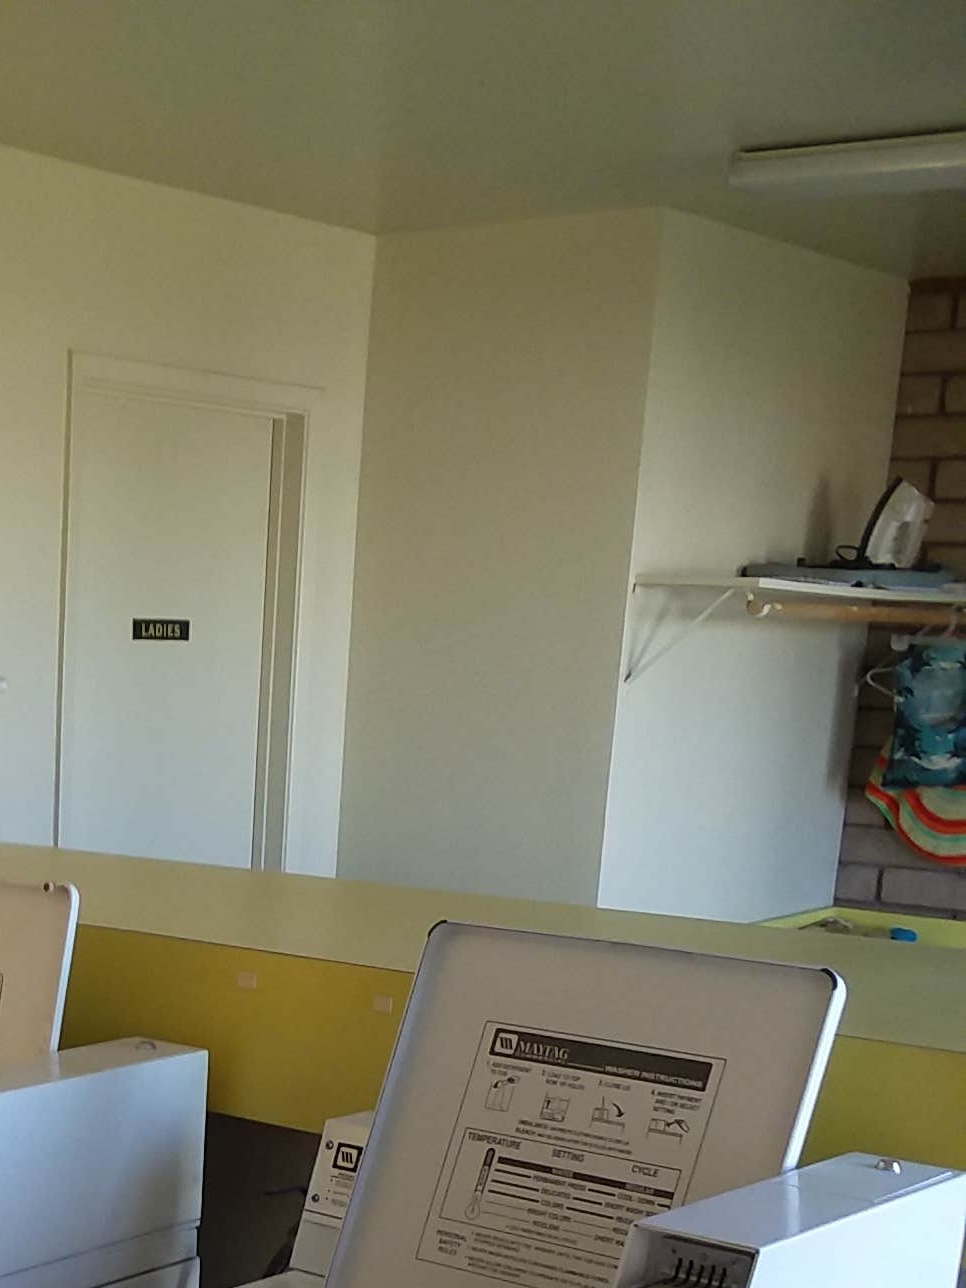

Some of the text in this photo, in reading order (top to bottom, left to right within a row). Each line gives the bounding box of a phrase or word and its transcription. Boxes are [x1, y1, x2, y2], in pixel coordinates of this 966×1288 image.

[141, 623, 181, 637] LADIES
[519, 1041, 570, 1060] MAYTAG
[605, 1065, 704, 1087] WASHER INSTRUCTIONS
[468, 1132, 522, 1150] TEMPERATURE
[551, 1148, 584, 1162] SETTING
[631, 1165, 659, 1178] CYCLE
